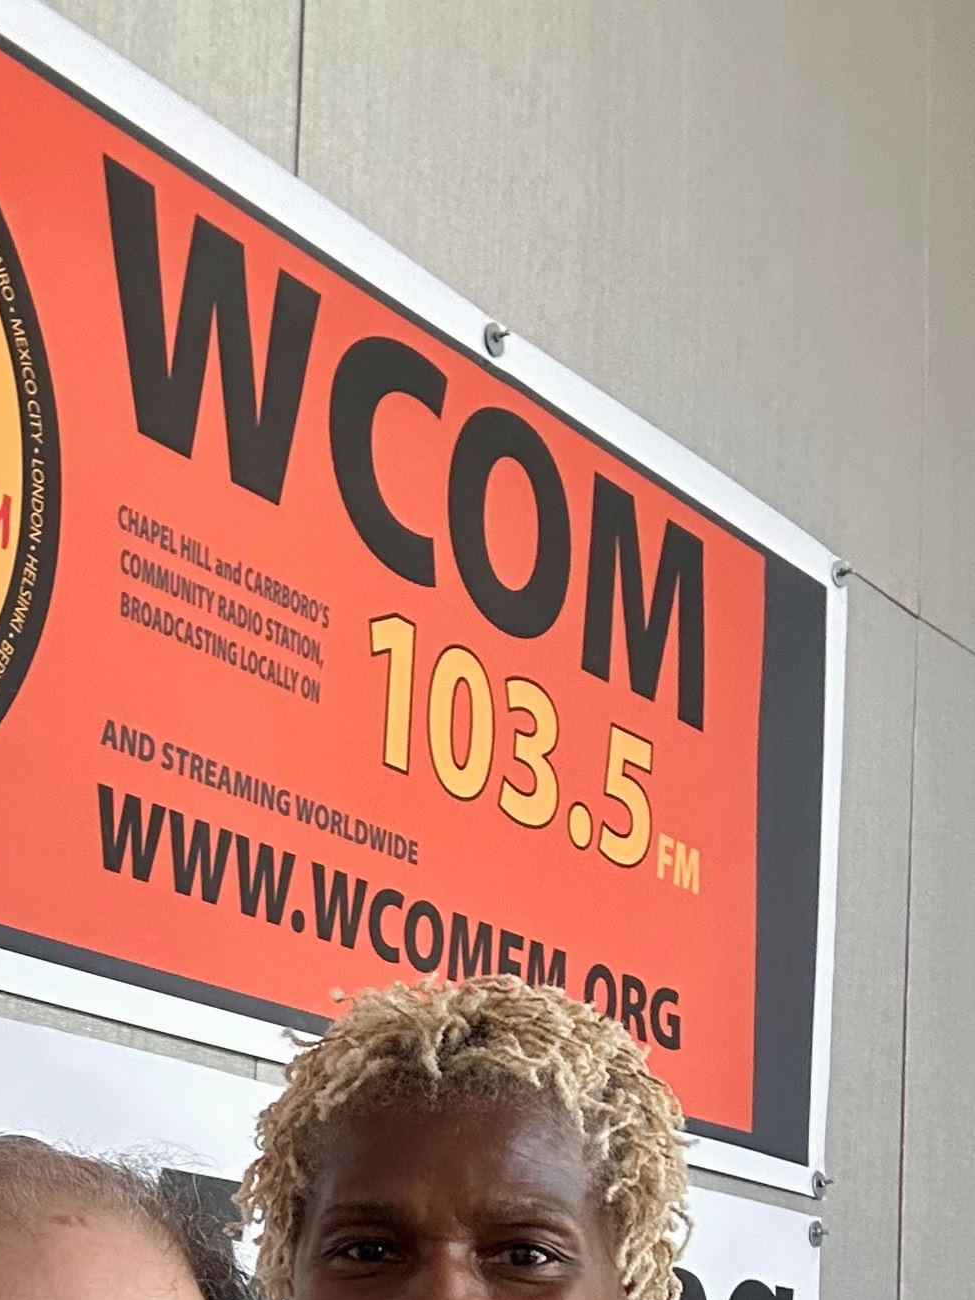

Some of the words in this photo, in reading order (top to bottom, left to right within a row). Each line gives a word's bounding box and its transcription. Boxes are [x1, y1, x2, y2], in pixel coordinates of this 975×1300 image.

[10, 318, 38, 395] MEXICO
[27, 400, 43, 444] CITY
[103, 151, 705, 733] WCOM
[29, 458, 45, 544] LONDON
[9, 553, 39, 634] HELSINKI
[117, 504, 177, 555] CHAPEL
[180, 534, 212, 572] HILL
[214, 557, 242, 587] and
[244, 566, 330, 629] CARRBORO'S
[120, 548, 215, 613] COMMUNITY
[217, 594, 263, 636] RADIO
[265, 617, 324, 669] STATION,
[120, 591, 238, 666] BROADCASTING
[240, 645, 299, 693] LOCALLY
[300, 675, 321, 704] ON
[100, 719, 156, 762] AND
[161, 742, 291, 817] STREAMING
[295, 793, 419, 865] WORLDWIDE
[369, 612, 653, 869] 103.5
[656, 832, 701, 895] FM
[97, 782, 682, 1050] WWW.WCOMFMORG
